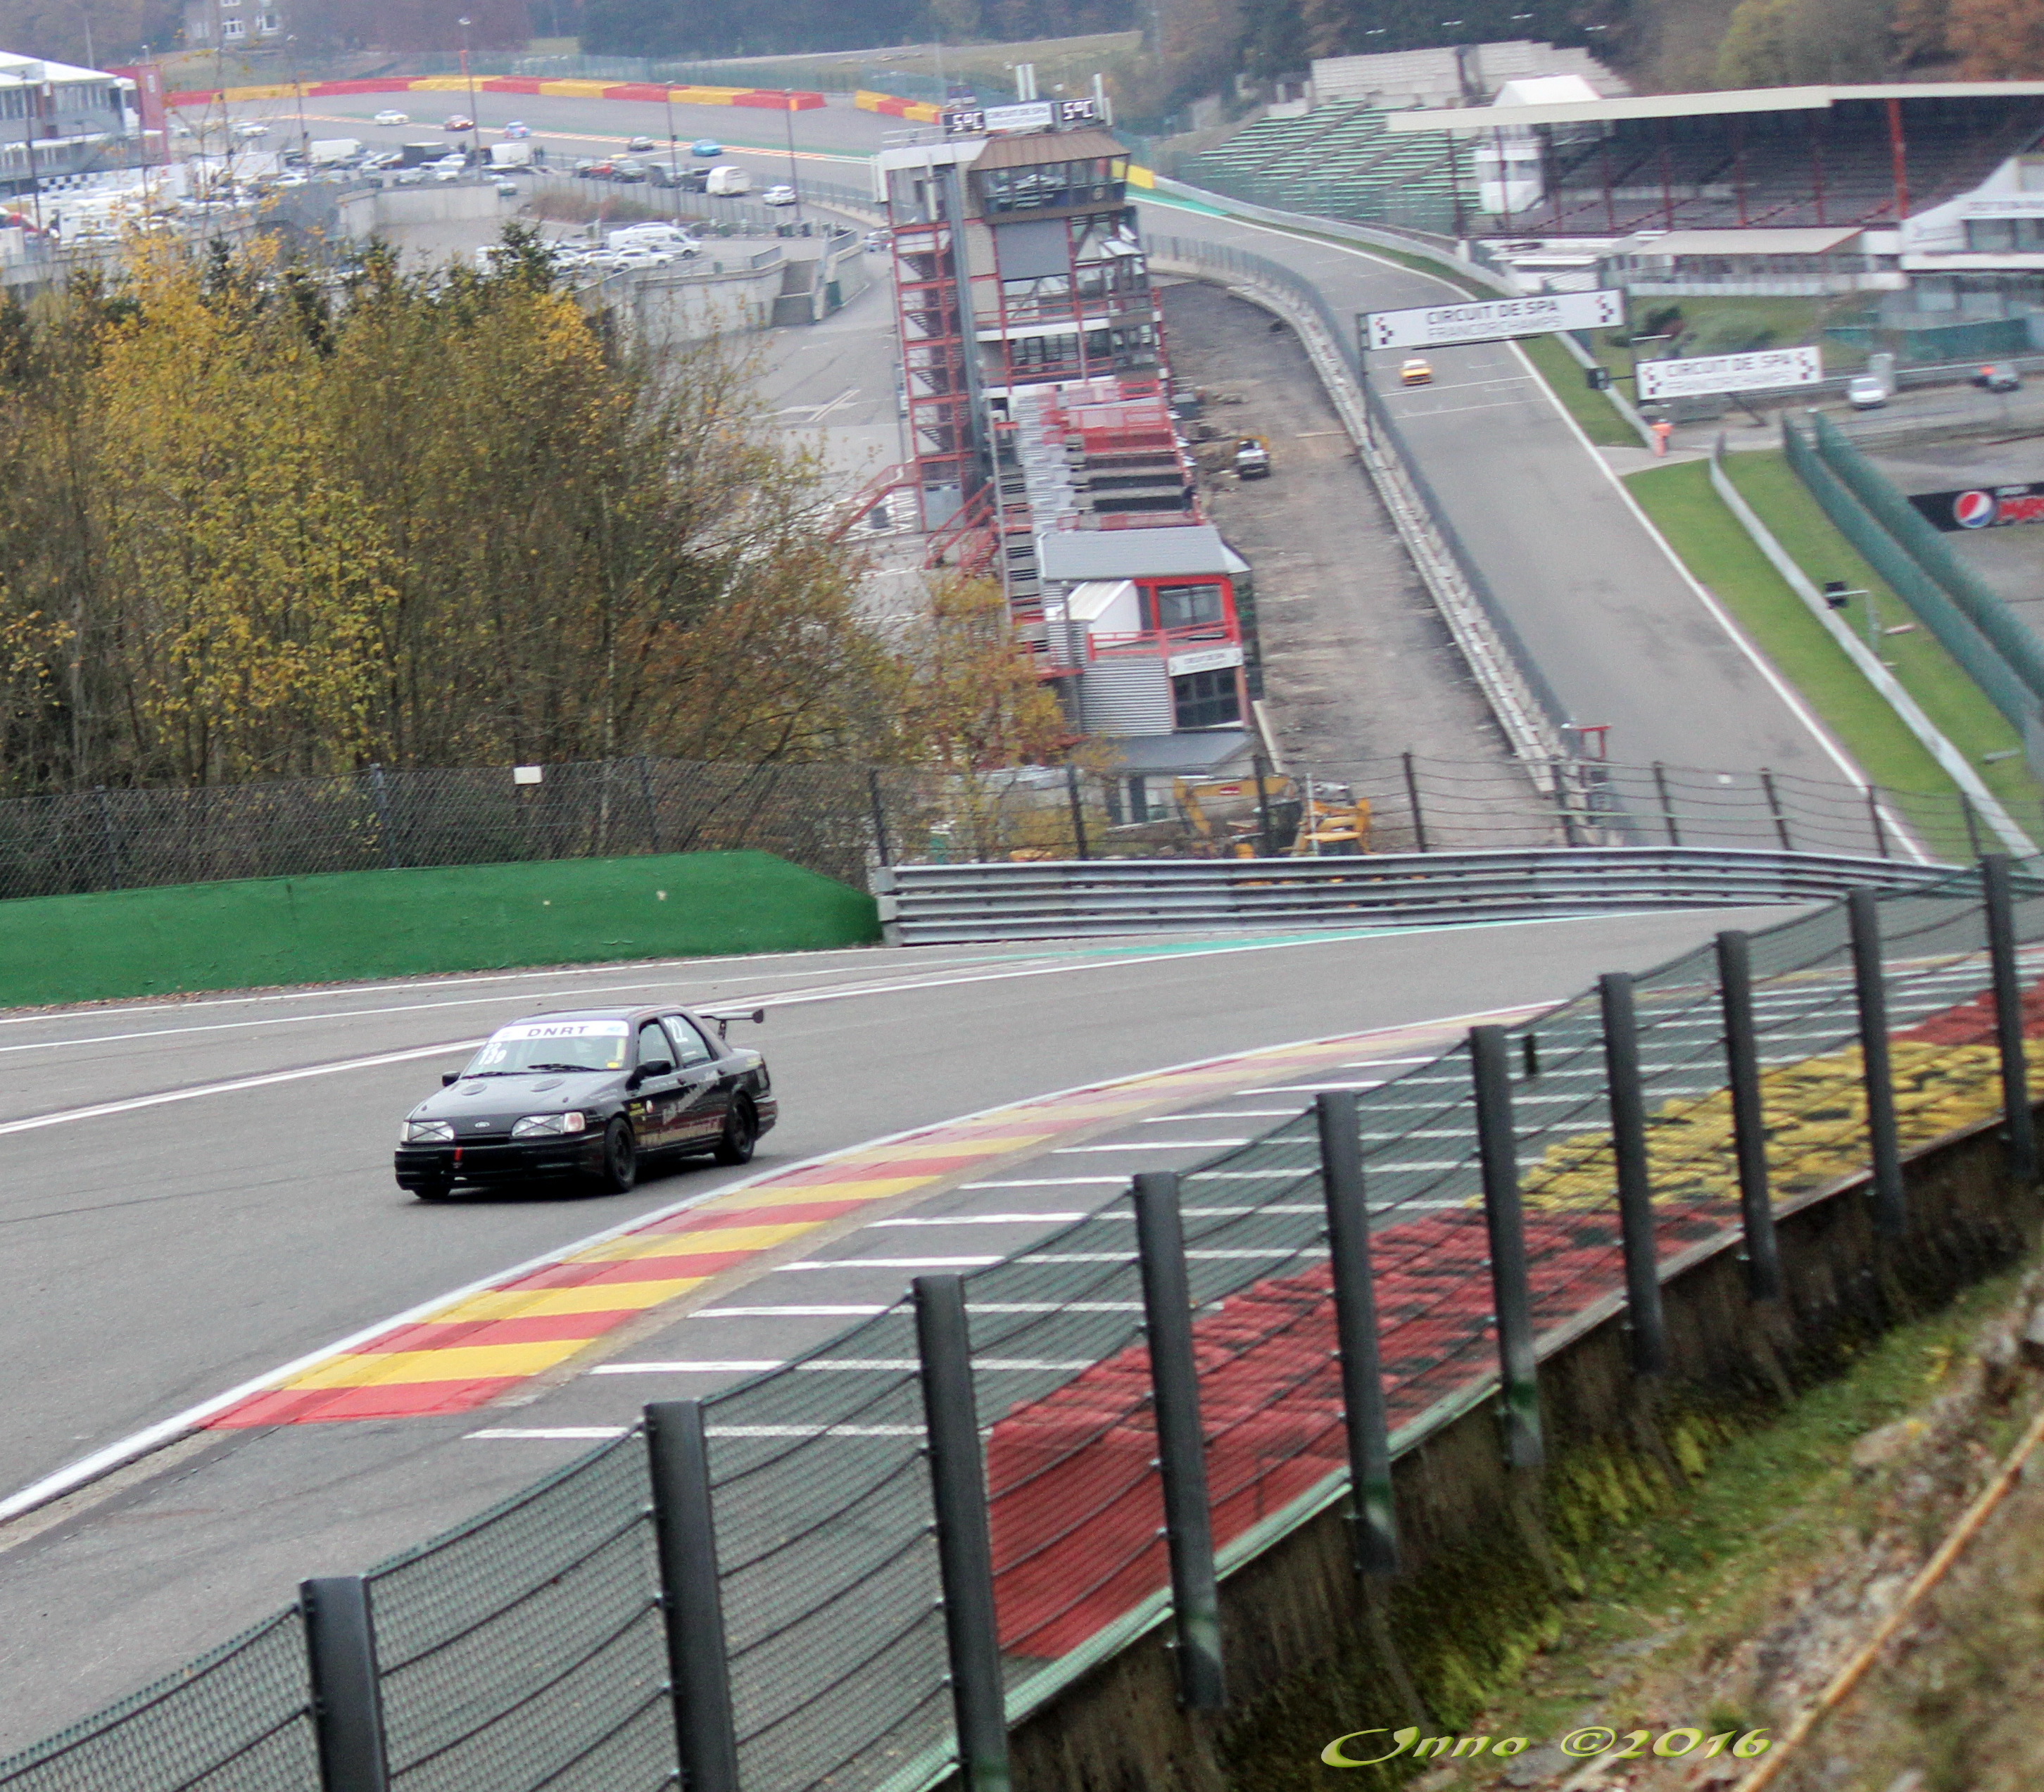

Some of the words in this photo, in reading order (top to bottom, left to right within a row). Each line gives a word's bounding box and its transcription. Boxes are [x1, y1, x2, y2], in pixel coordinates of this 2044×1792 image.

[1427, 305, 1492, 324] CIRCUIT
[1499, 303, 1521, 317] DE
[1526, 300, 1558, 315] SPA
[526, 1026, 589, 1037] DNRT
